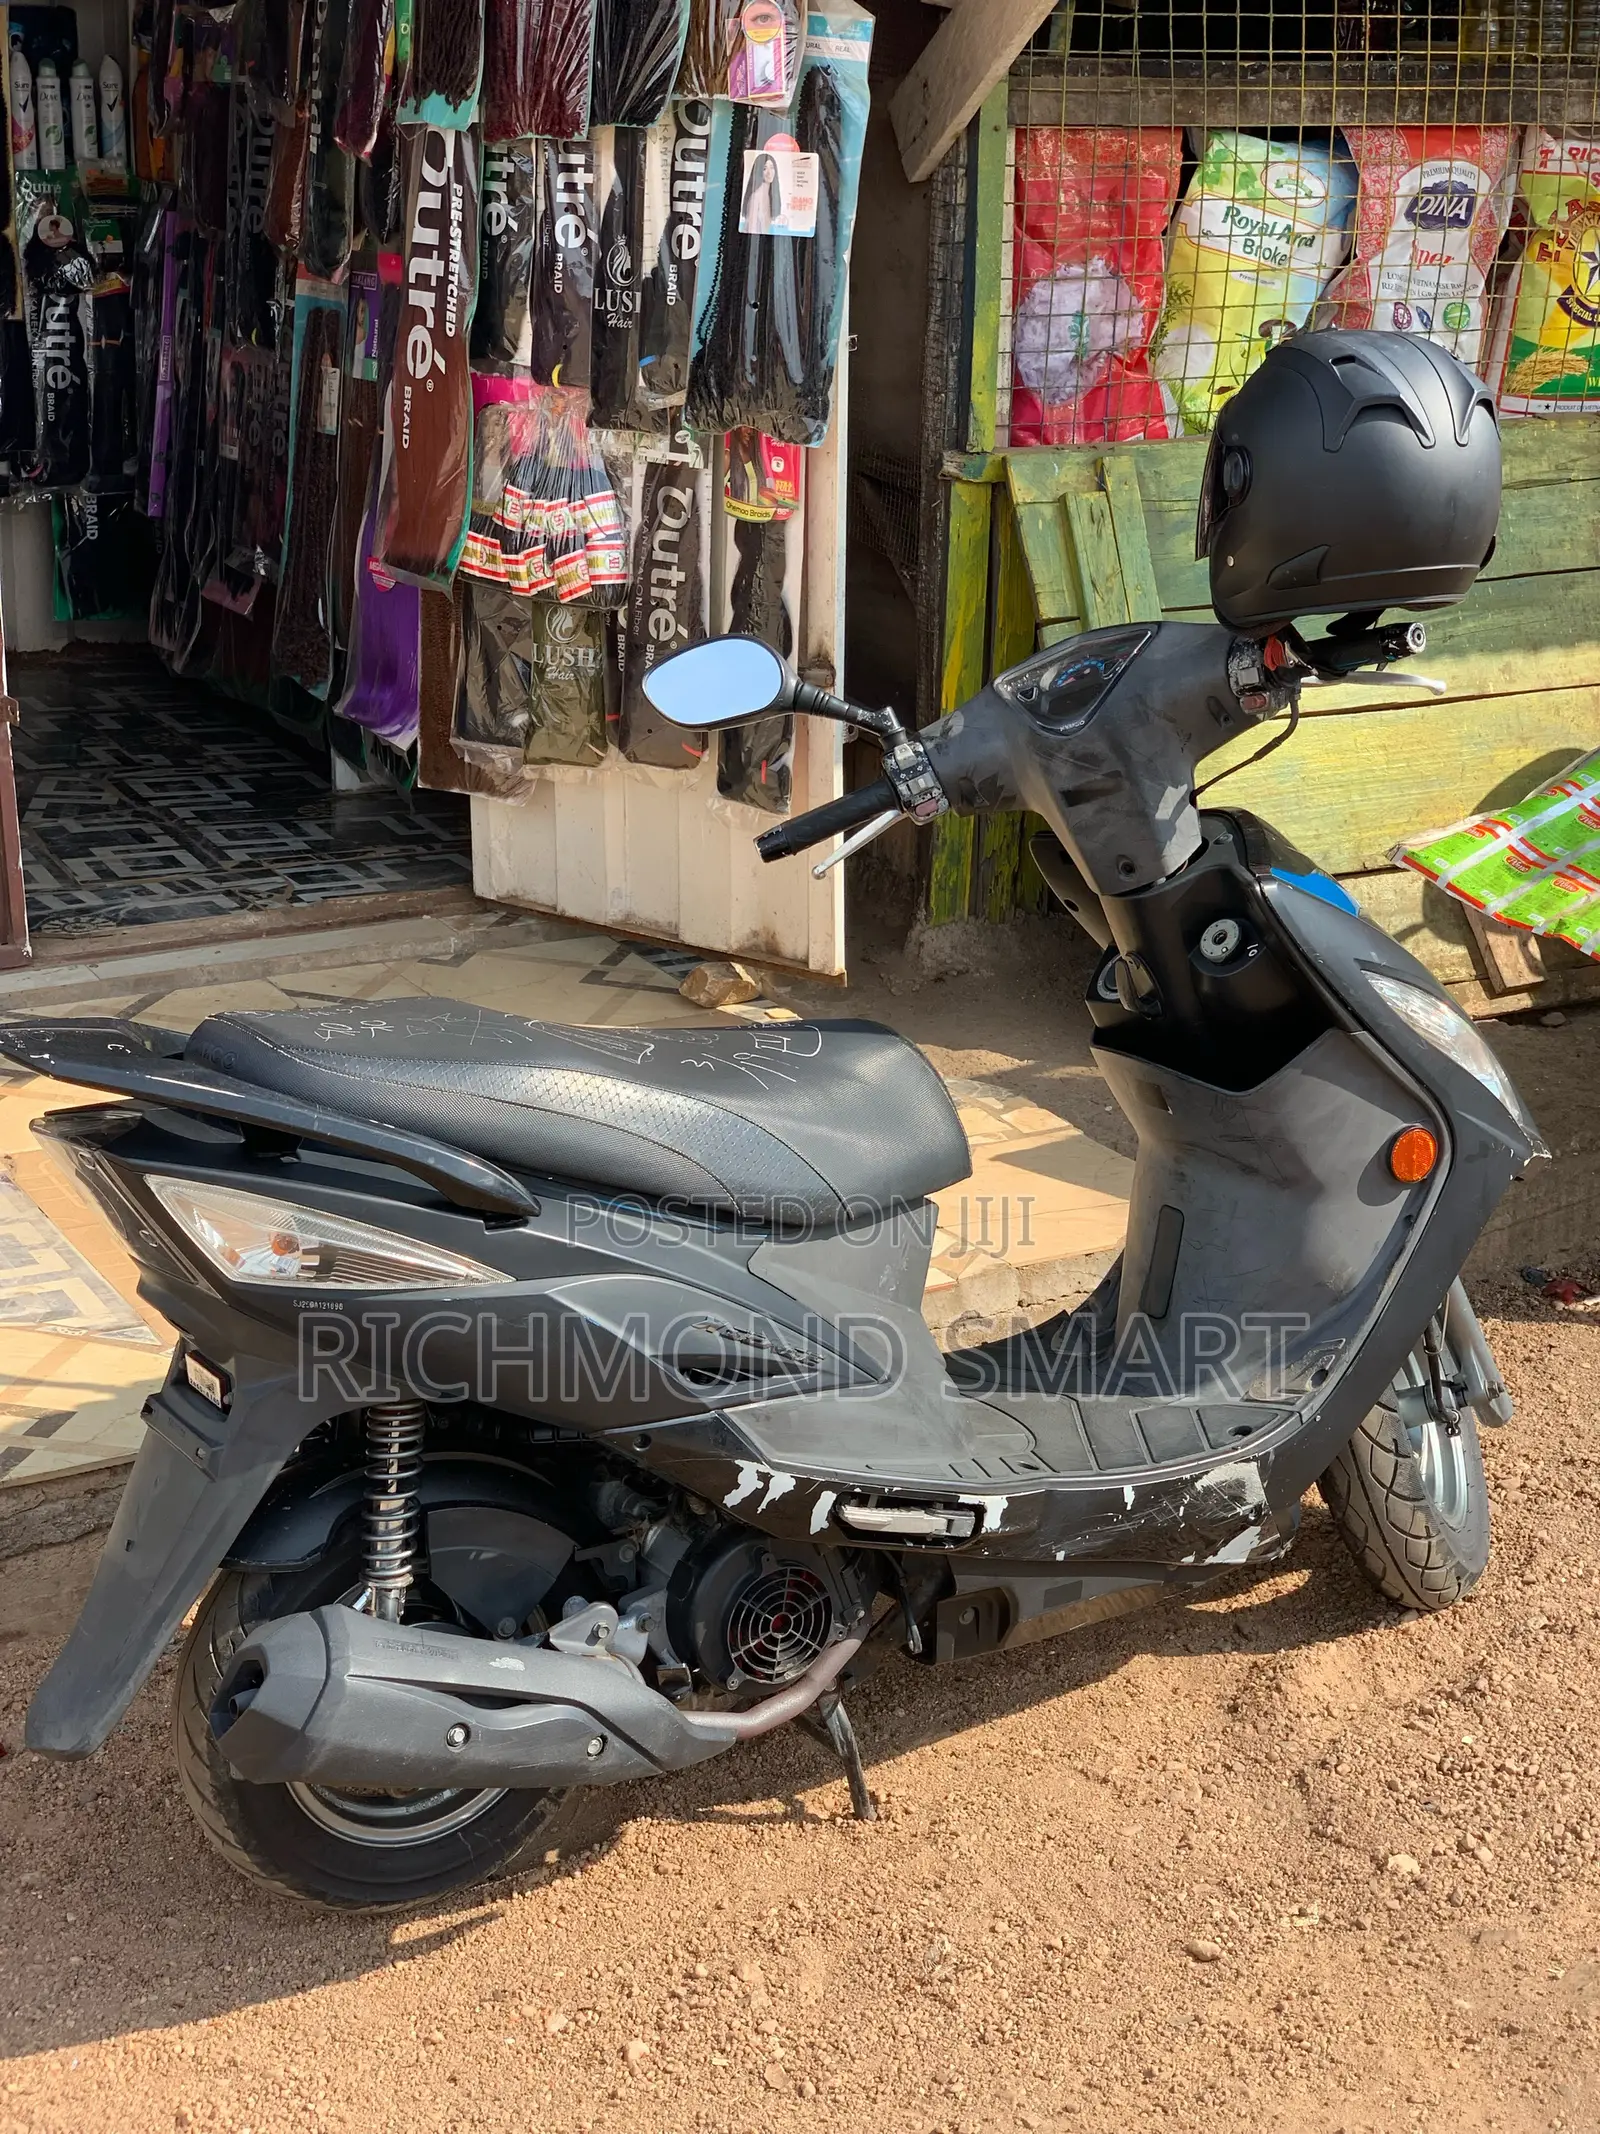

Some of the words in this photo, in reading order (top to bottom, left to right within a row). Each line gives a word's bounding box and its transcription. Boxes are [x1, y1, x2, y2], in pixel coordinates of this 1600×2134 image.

[1452, 166, 1477, 181] QUALITY
[1221, 206, 1278, 238] Royal
[1413, 195, 1469, 221] DINA
[444, 182, 463, 338] PRE-STRETCHED
[666, 264, 678, 306] BRAID
[607, 312, 633, 329] Hair
[46, 391, 56, 423] BRAID
[401, 385, 413, 450] BRAID
[85, 494, 99, 541] BRAID
[749, 510, 771, 518] Braids
[648, 485, 693, 642] Outré
[532, 643, 594, 667] LUSH
[617, 633, 626, 672] BRAID
[644, 643, 655, 670] BRA
[545, 667, 576, 681] Hair
